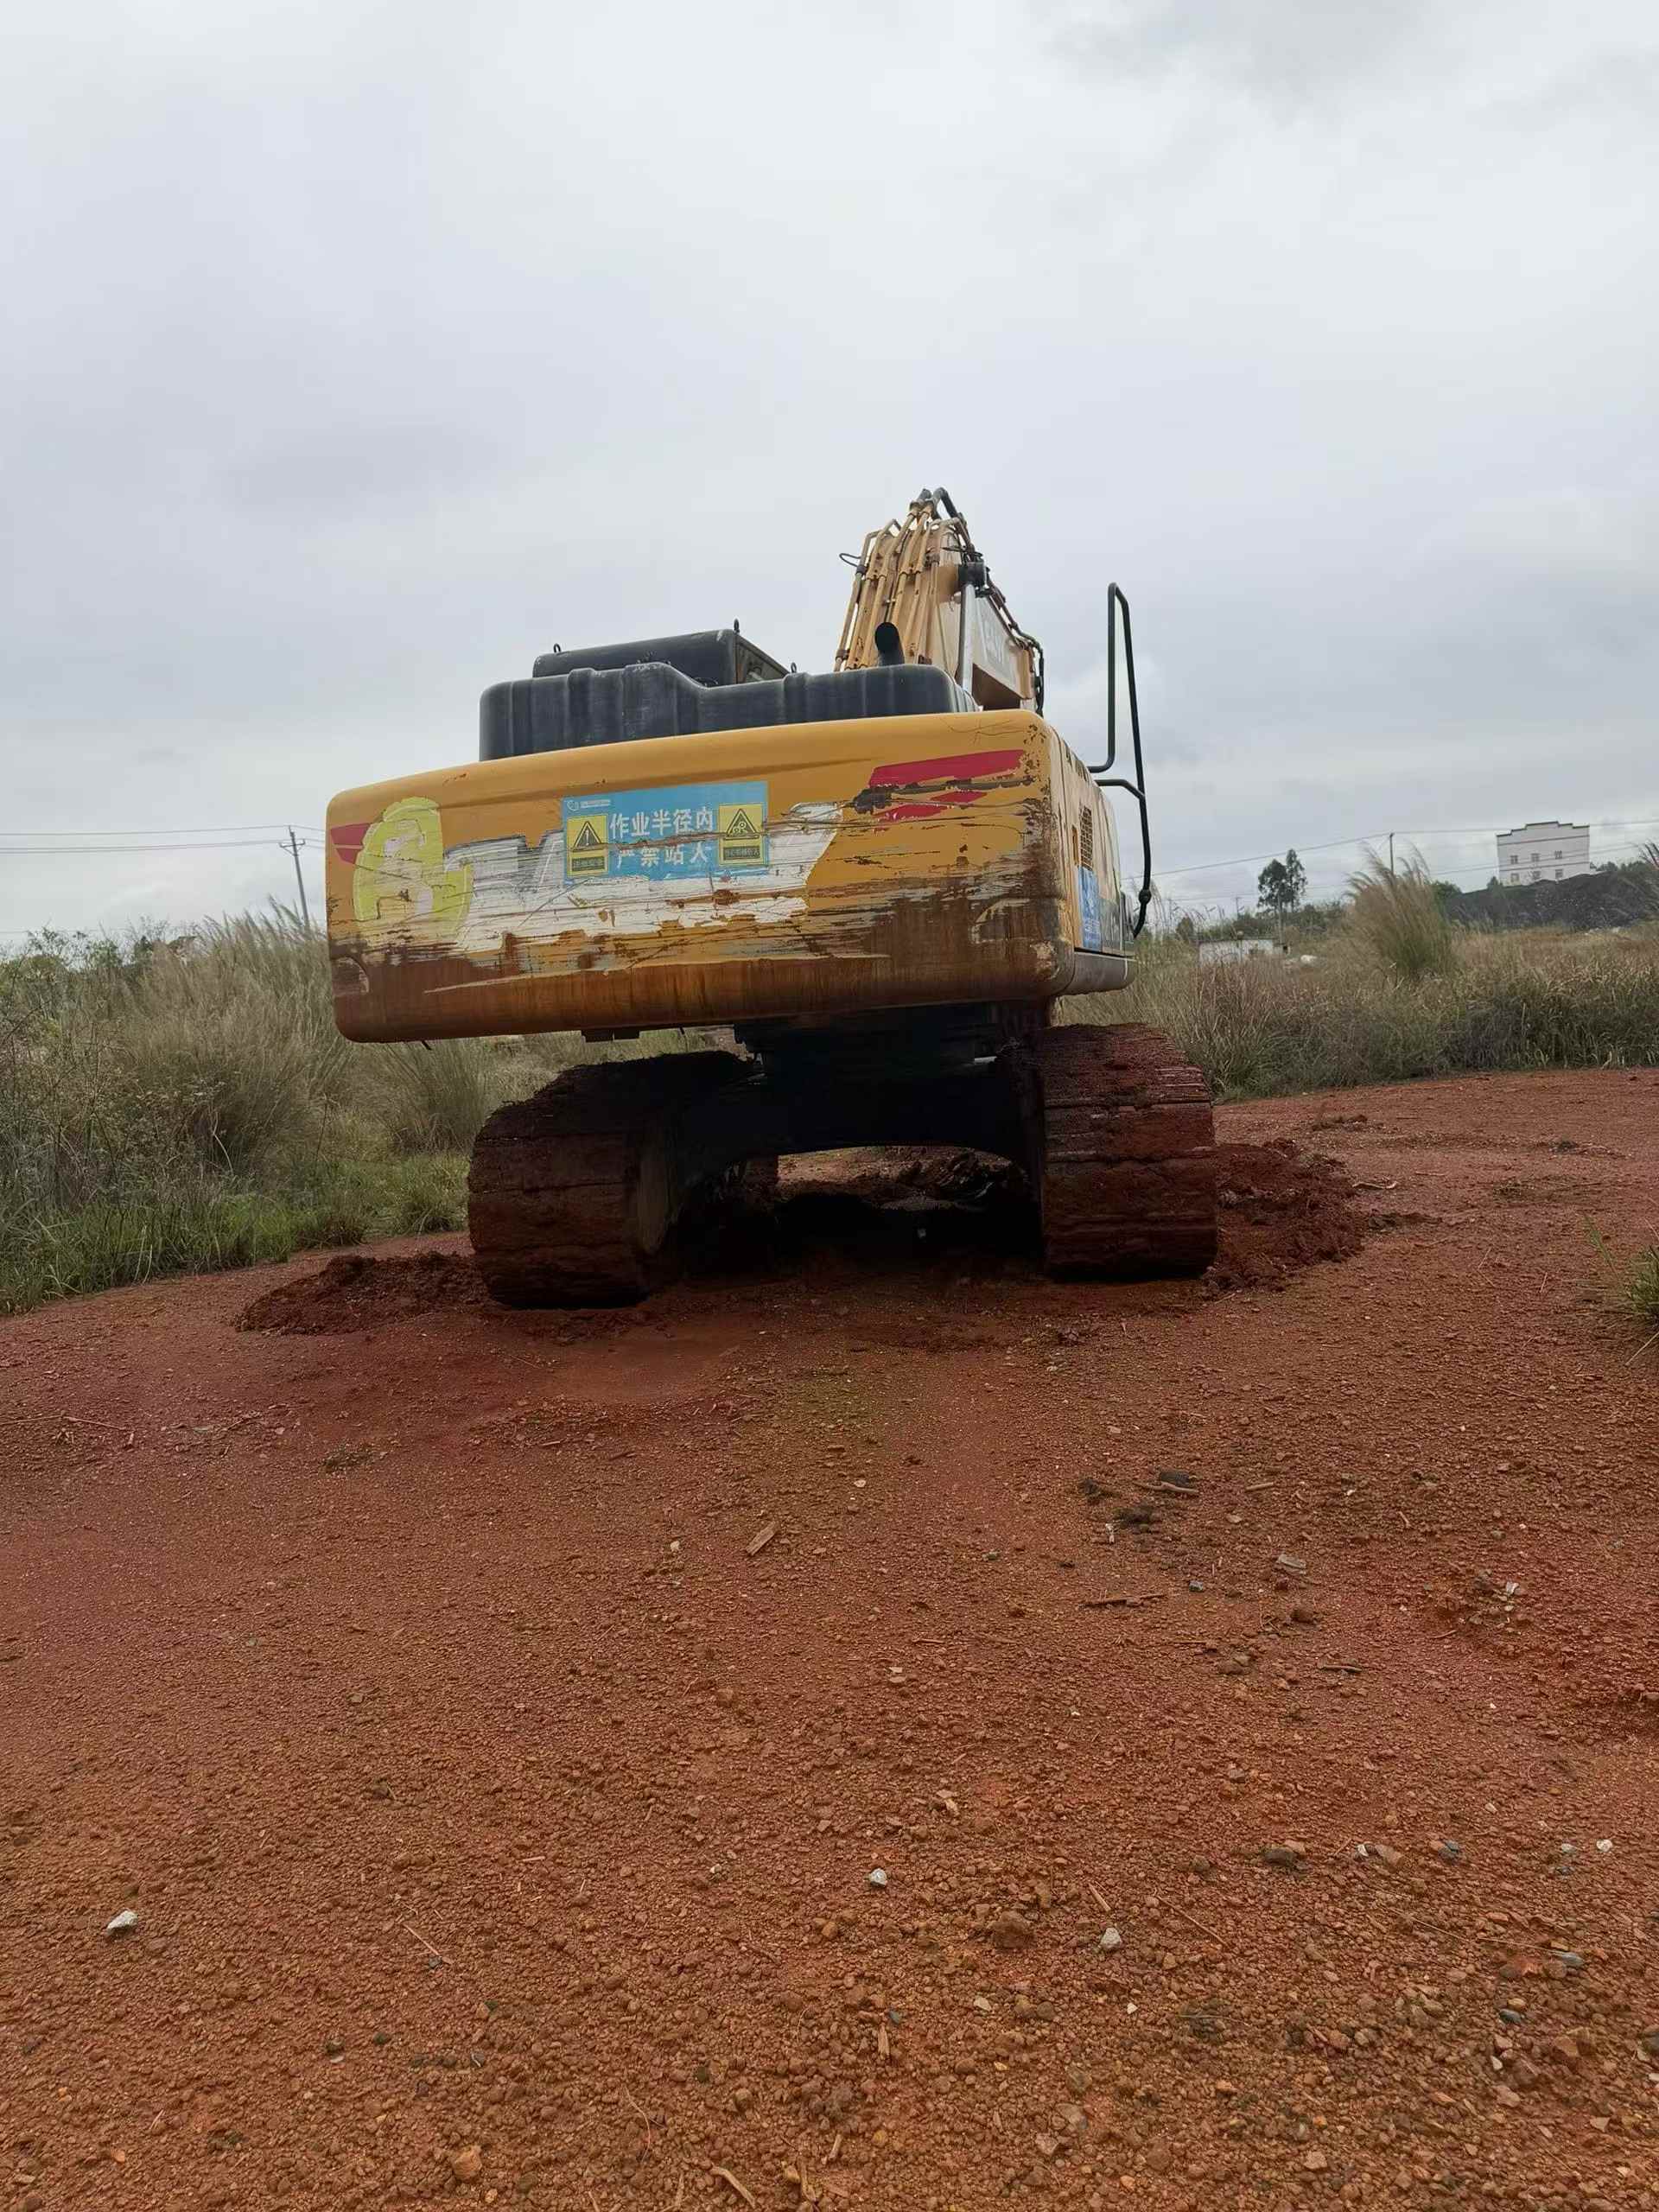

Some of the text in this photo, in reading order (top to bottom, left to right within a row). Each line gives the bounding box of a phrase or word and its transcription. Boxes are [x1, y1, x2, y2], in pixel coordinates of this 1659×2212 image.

[610, 806, 713, 839] 作业半径内
